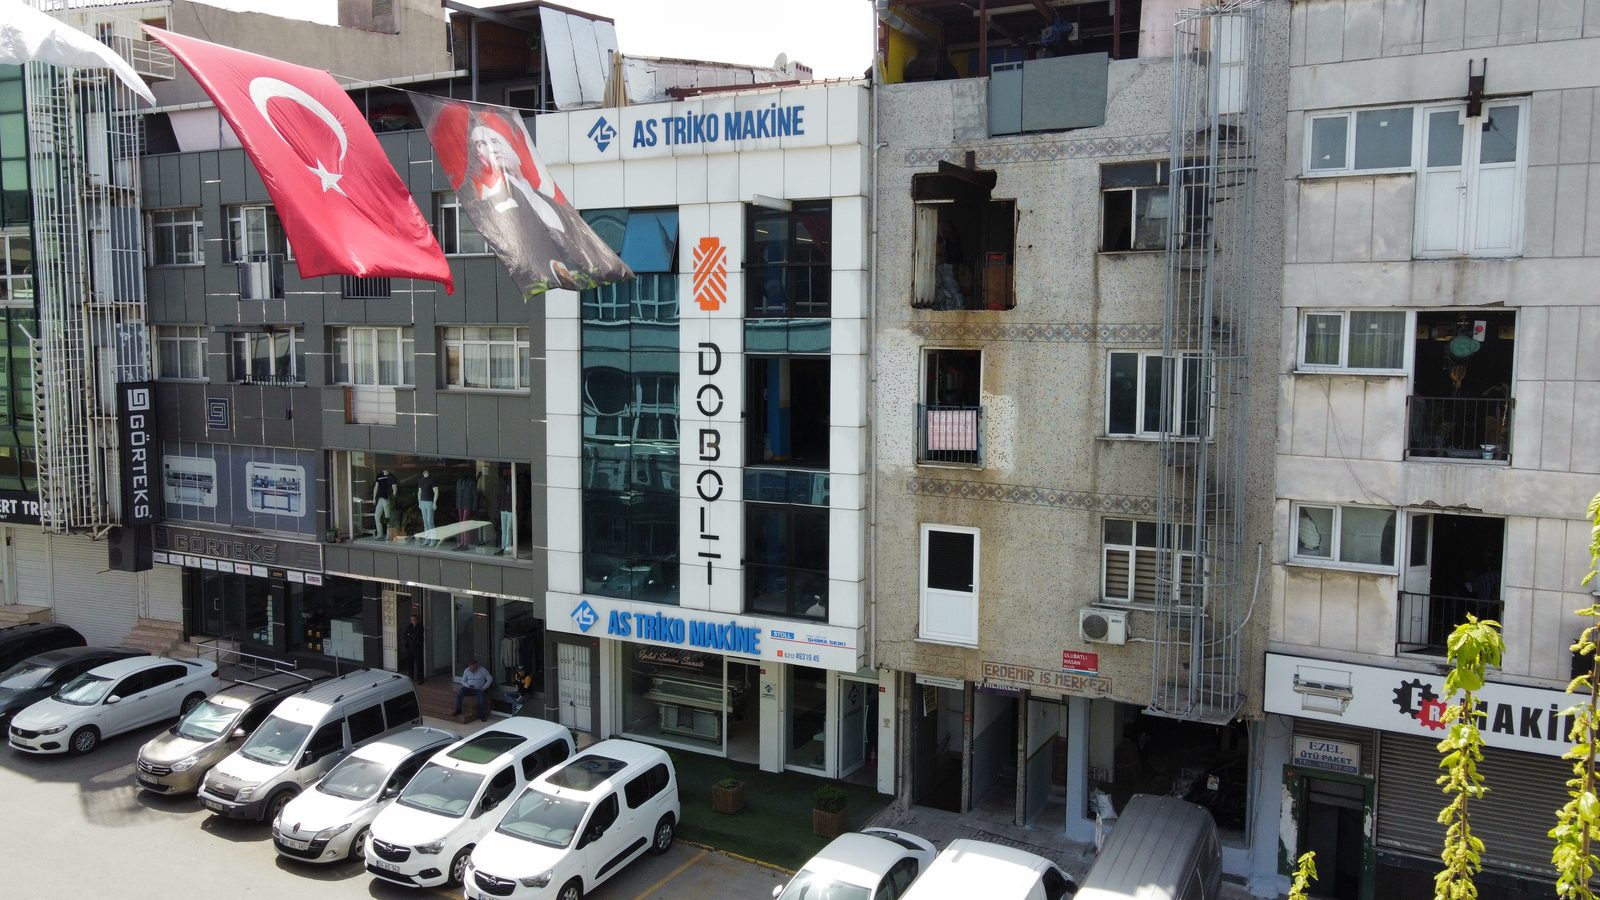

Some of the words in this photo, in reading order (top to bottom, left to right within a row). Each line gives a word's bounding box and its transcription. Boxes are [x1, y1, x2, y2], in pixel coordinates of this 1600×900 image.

[633, 118, 658, 149] AS
[662, 110, 718, 145] TRİKO
[725, 103, 805, 141] MAKİNE
[130, 414, 151, 519] GÖRTEKS
[174, 531, 276, 563] GÖRTEKS
[608, 610, 631, 637] AS
[634, 611, 685, 645] TRİKO
[689, 620, 761, 655] MAKİNE
[773, 631, 791, 639] STOLL
[1300, 750, 1319, 760] ÜTÜ
[1322, 755, 1353, 765] PAKET
[1309, 741, 1344, 754] EZEL
